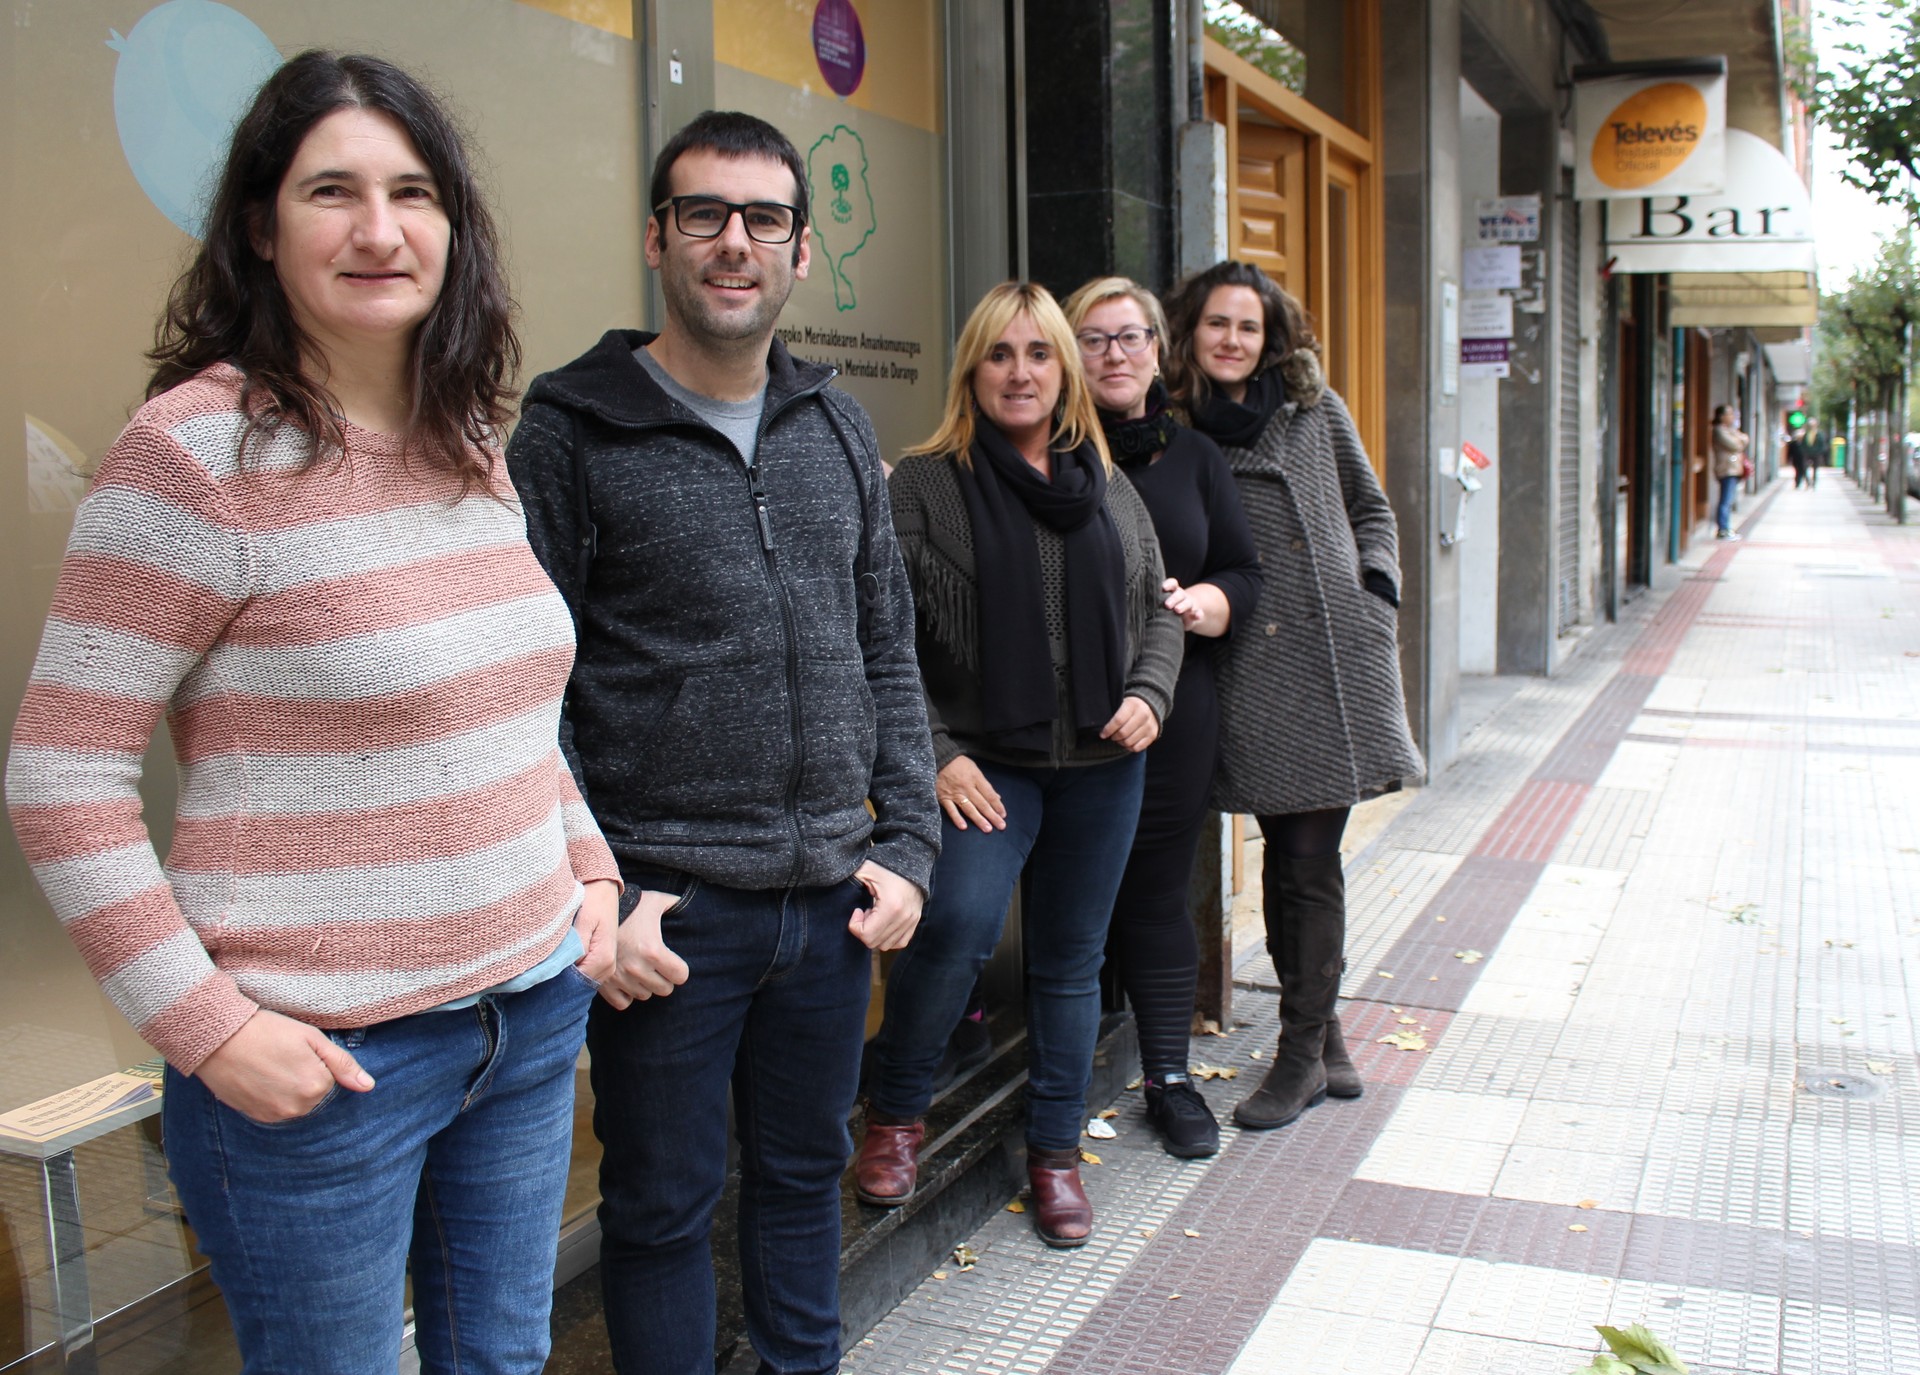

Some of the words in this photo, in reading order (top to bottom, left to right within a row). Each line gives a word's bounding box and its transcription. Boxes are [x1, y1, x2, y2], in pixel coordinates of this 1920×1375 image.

[1611, 121, 1698, 145] Televés
[1630, 195, 1790, 238] Bar
[805, 325, 858, 348] Merinaldearen
[845, 358, 878, 378] Merindad
[880, 361, 888, 379] de
[890, 362, 918, 385] Durango
